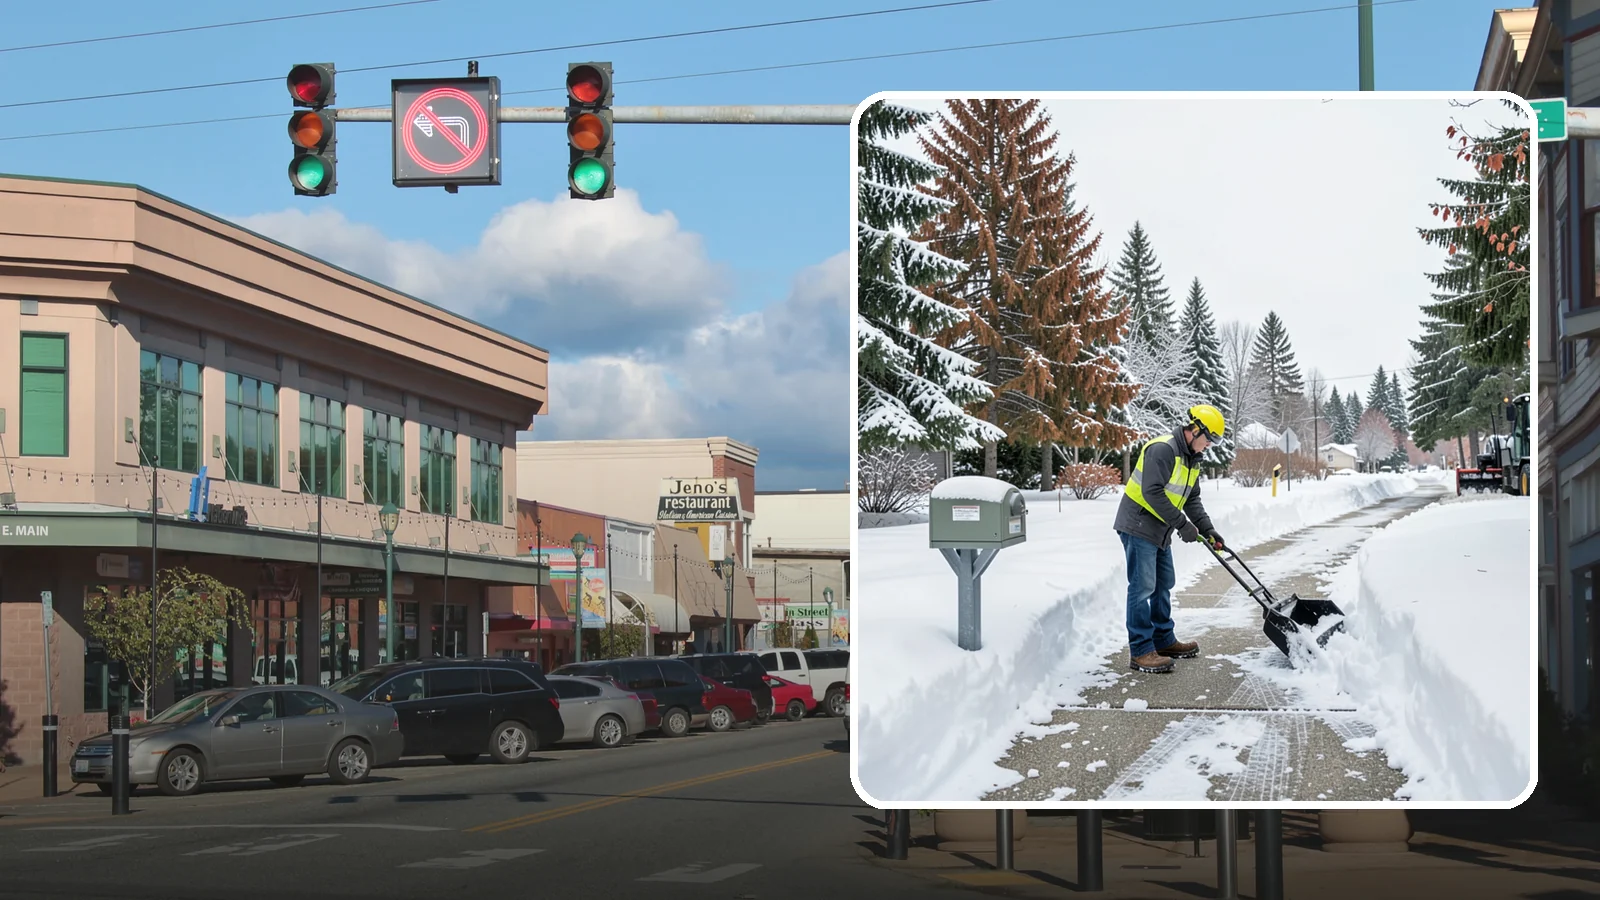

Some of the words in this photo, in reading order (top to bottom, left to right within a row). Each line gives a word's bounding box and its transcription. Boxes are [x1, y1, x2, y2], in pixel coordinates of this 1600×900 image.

[670, 480, 727, 494] Jeno's
[665, 496, 731, 509] restaurant
[659, 510, 681, 519] Italian
[686, 510, 714, 519] American
[715, 509, 737, 519] Cuisine
[2, 525, 13, 536] E.
[15, 525, 49, 536] MAIN
[797, 607, 828, 617] Street
[791, 619, 823, 627] lass
